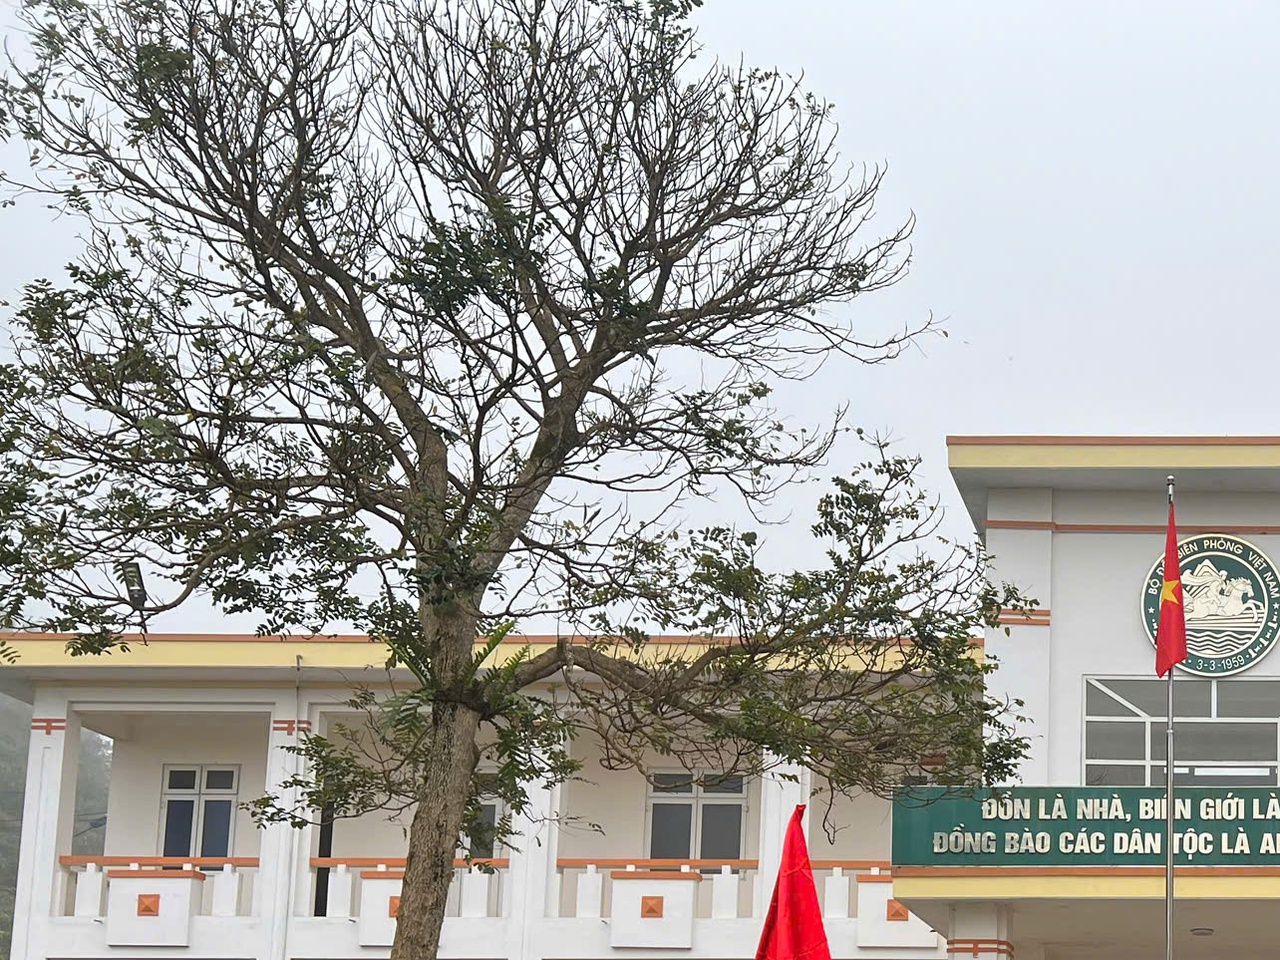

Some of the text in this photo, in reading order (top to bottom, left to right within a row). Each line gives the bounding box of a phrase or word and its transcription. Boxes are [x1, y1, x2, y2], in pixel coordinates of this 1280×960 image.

[1203, 538, 1244, 555] PHÒNG
[1248, 551, 1267, 571] VIỆT
[1263, 573, 1280, 599] NAM
[981, 790, 1031, 820] ĐỒN
[1038, 793, 1068, 820] LÀ
[1076, 793, 1131, 822] NHÀ,
[1199, 793, 1244, 820] GIỚI
[932, 823, 996, 854] ĐỒNG
[1004, 827, 1051, 854] BÀO
[1059, 827, 1106, 854] CÁC
[1113, 827, 1162, 854] DÂN
[1173, 827, 1214, 860] TỘC
[1221, 827, 1251, 854] LÀ
